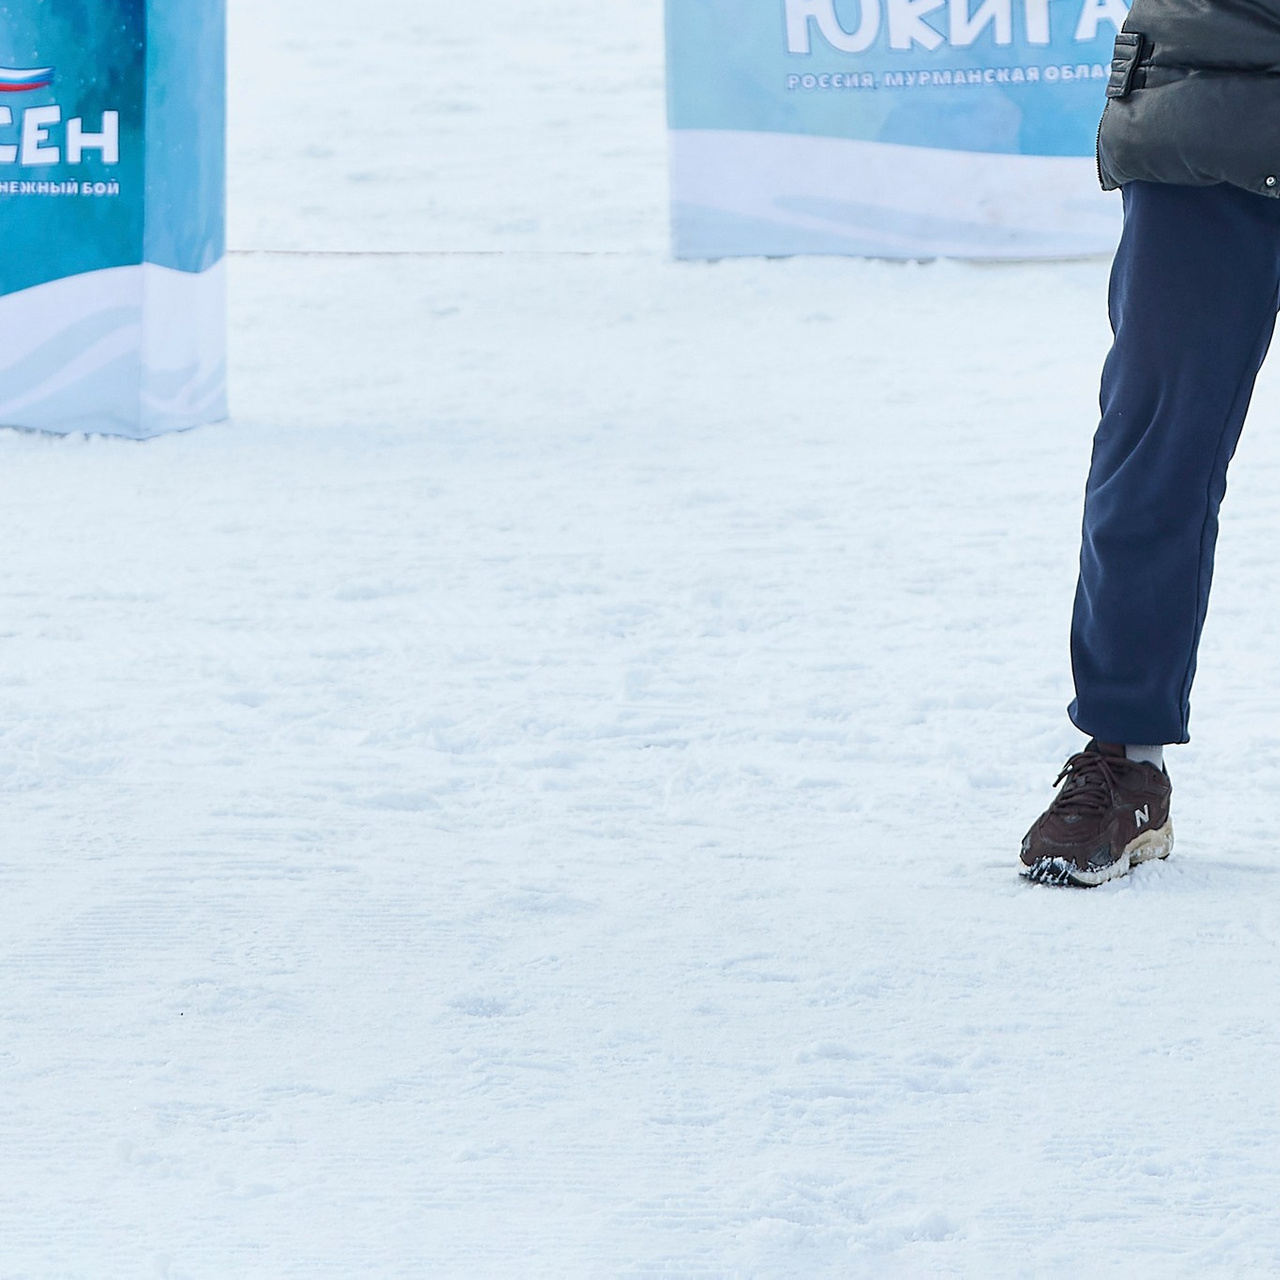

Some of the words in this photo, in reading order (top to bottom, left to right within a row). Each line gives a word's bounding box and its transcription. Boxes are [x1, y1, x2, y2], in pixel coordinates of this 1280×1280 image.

[787, 72, 877, 90] РОССИЯ,
[885, 66, 1039, 87] МУРМАНСКАЯ
[82, 178, 120, 194] БОЙ
